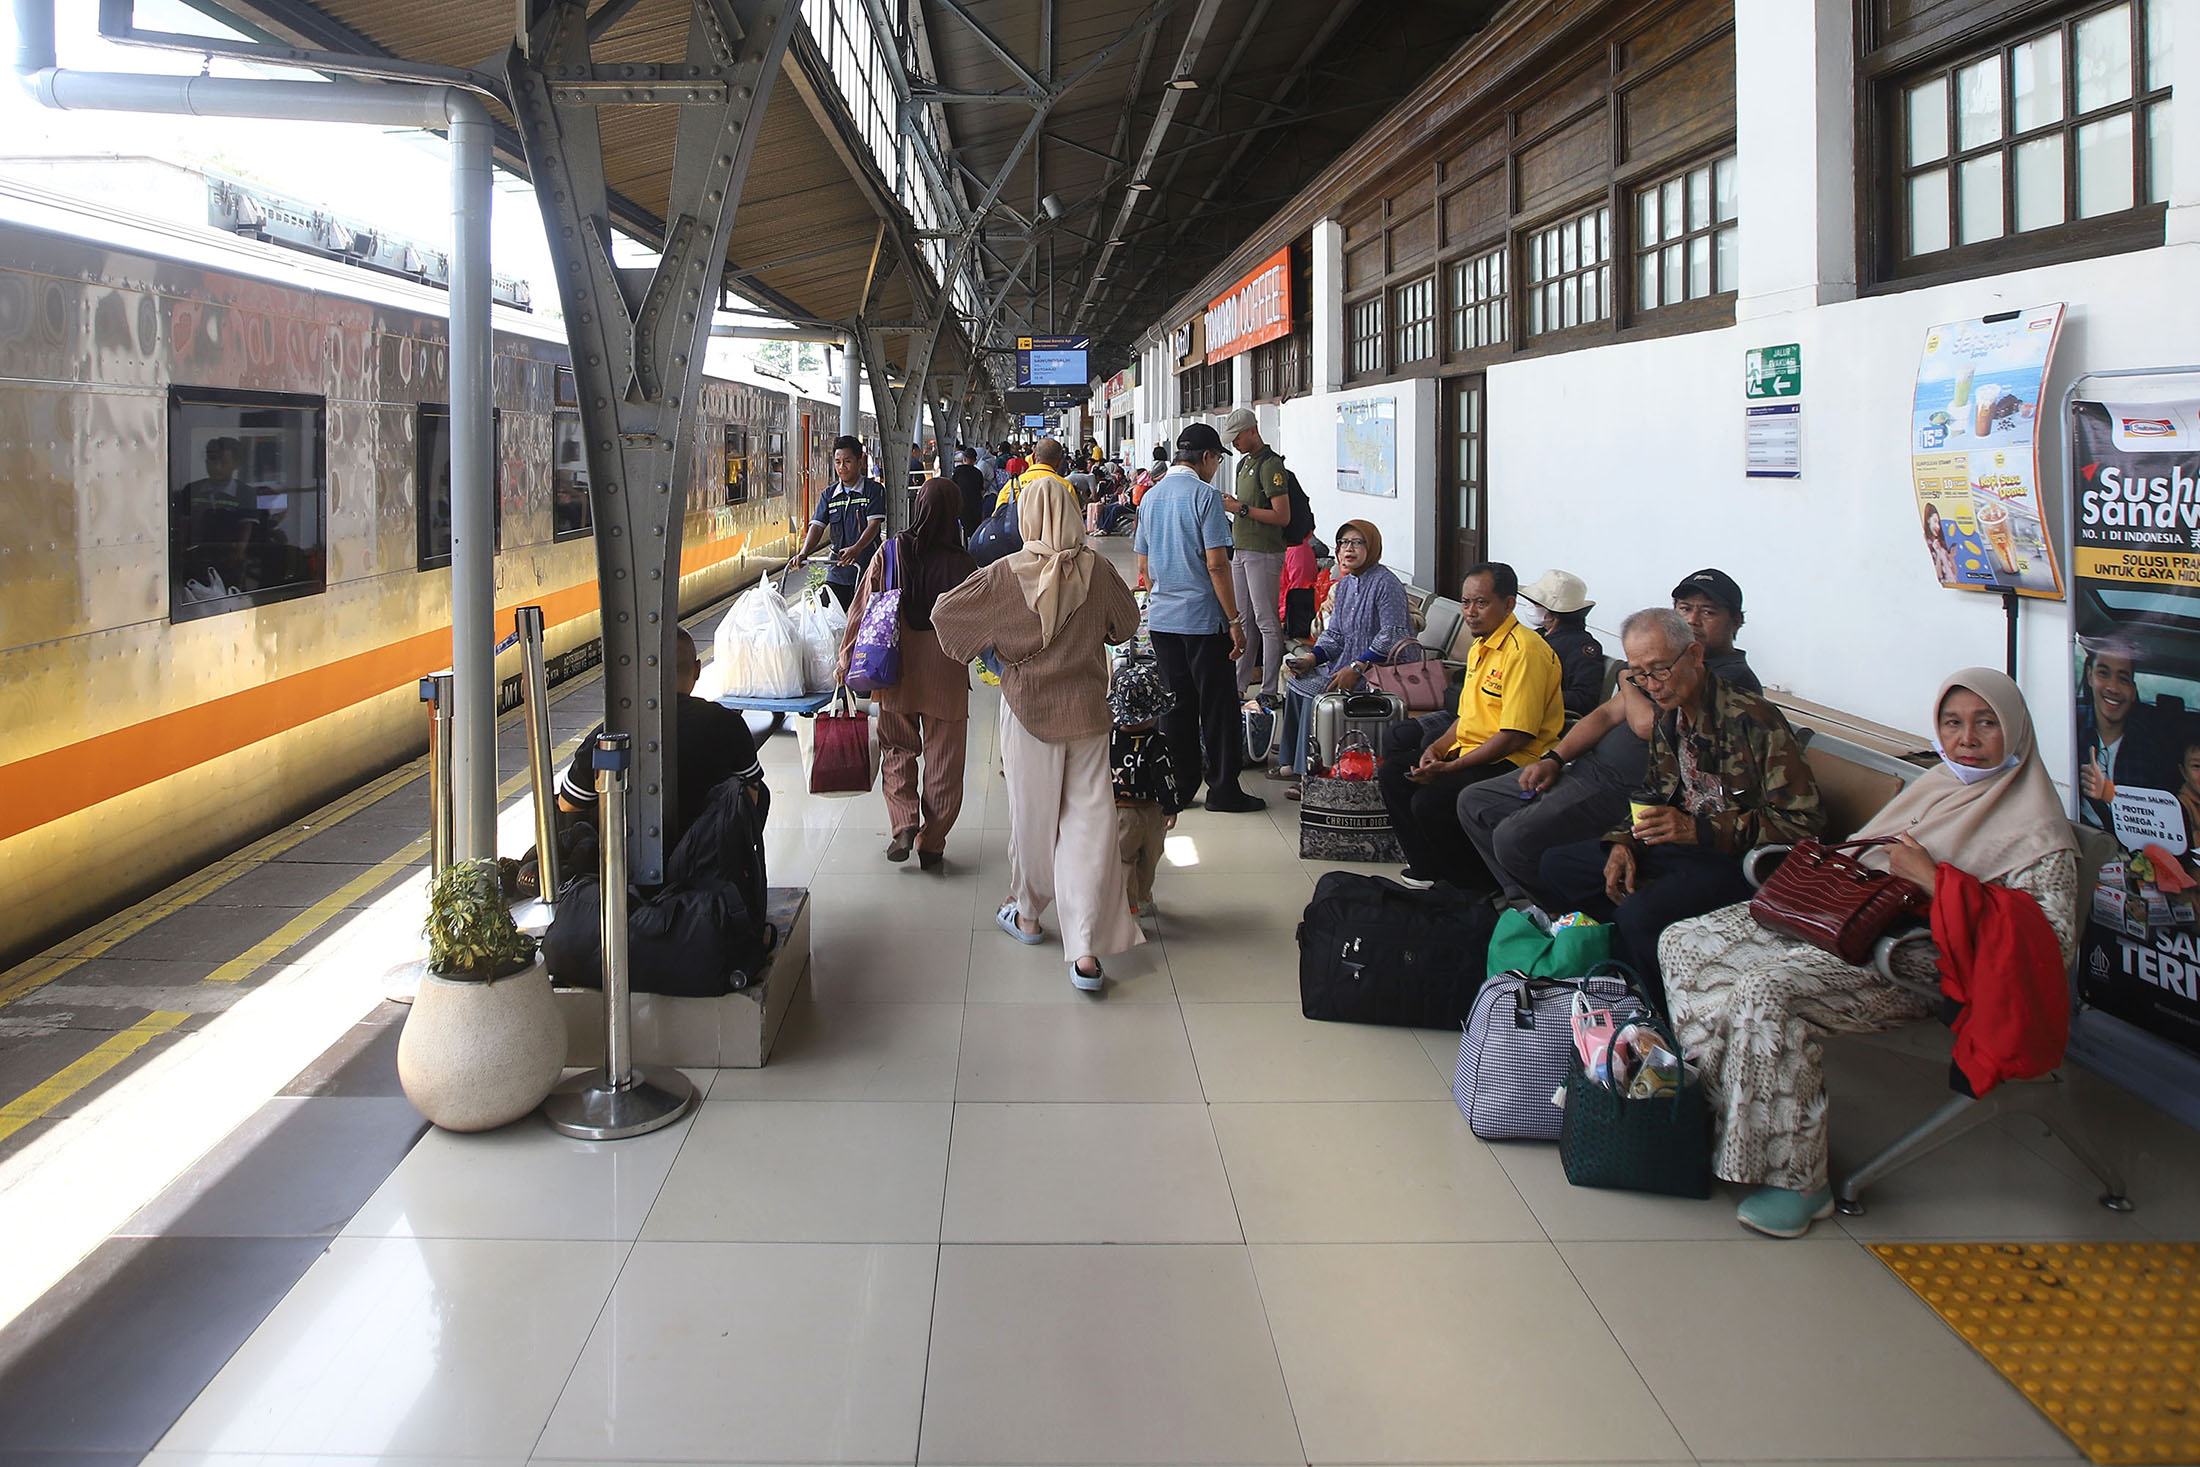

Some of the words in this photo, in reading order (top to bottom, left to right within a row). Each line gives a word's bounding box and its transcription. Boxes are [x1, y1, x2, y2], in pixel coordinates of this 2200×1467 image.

[1204, 294, 1237, 354] TOMORO
[1240, 265, 1283, 336] COFFEE
[1773, 347, 1791, 358] JALUR
[1021, 365, 1029, 375] 3
[1924, 429, 1935, 448] 15
[2099, 466, 2200, 503] Sushi
[2082, 529, 2098, 540] NO.
[2102, 531, 2106, 540] 1
[2110, 531, 2121, 541] DI
[2124, 531, 2184, 544] INDONESIA
[2122, 554, 2168, 568] SOLUSI
[2094, 564, 2134, 578] UNTUK
[2138, 567, 2175, 580] GAYA
[2113, 803, 2120, 811] 1.
[2122, 804, 2155, 817] PROTEIN
[1325, 816, 1367, 828] CHRISTIAN
[1369, 817, 1388, 827] DIOR
[2115, 813, 2122, 821] 2.
[2123, 815, 2152, 826] OMEGA
[2159, 821, 2165, 829] 3
[2124, 825, 2157, 838] VITAMIN
[2159, 831, 2165, 839] B
[2167, 833, 2174, 841] &
[2176, 834, 2184, 842] D
